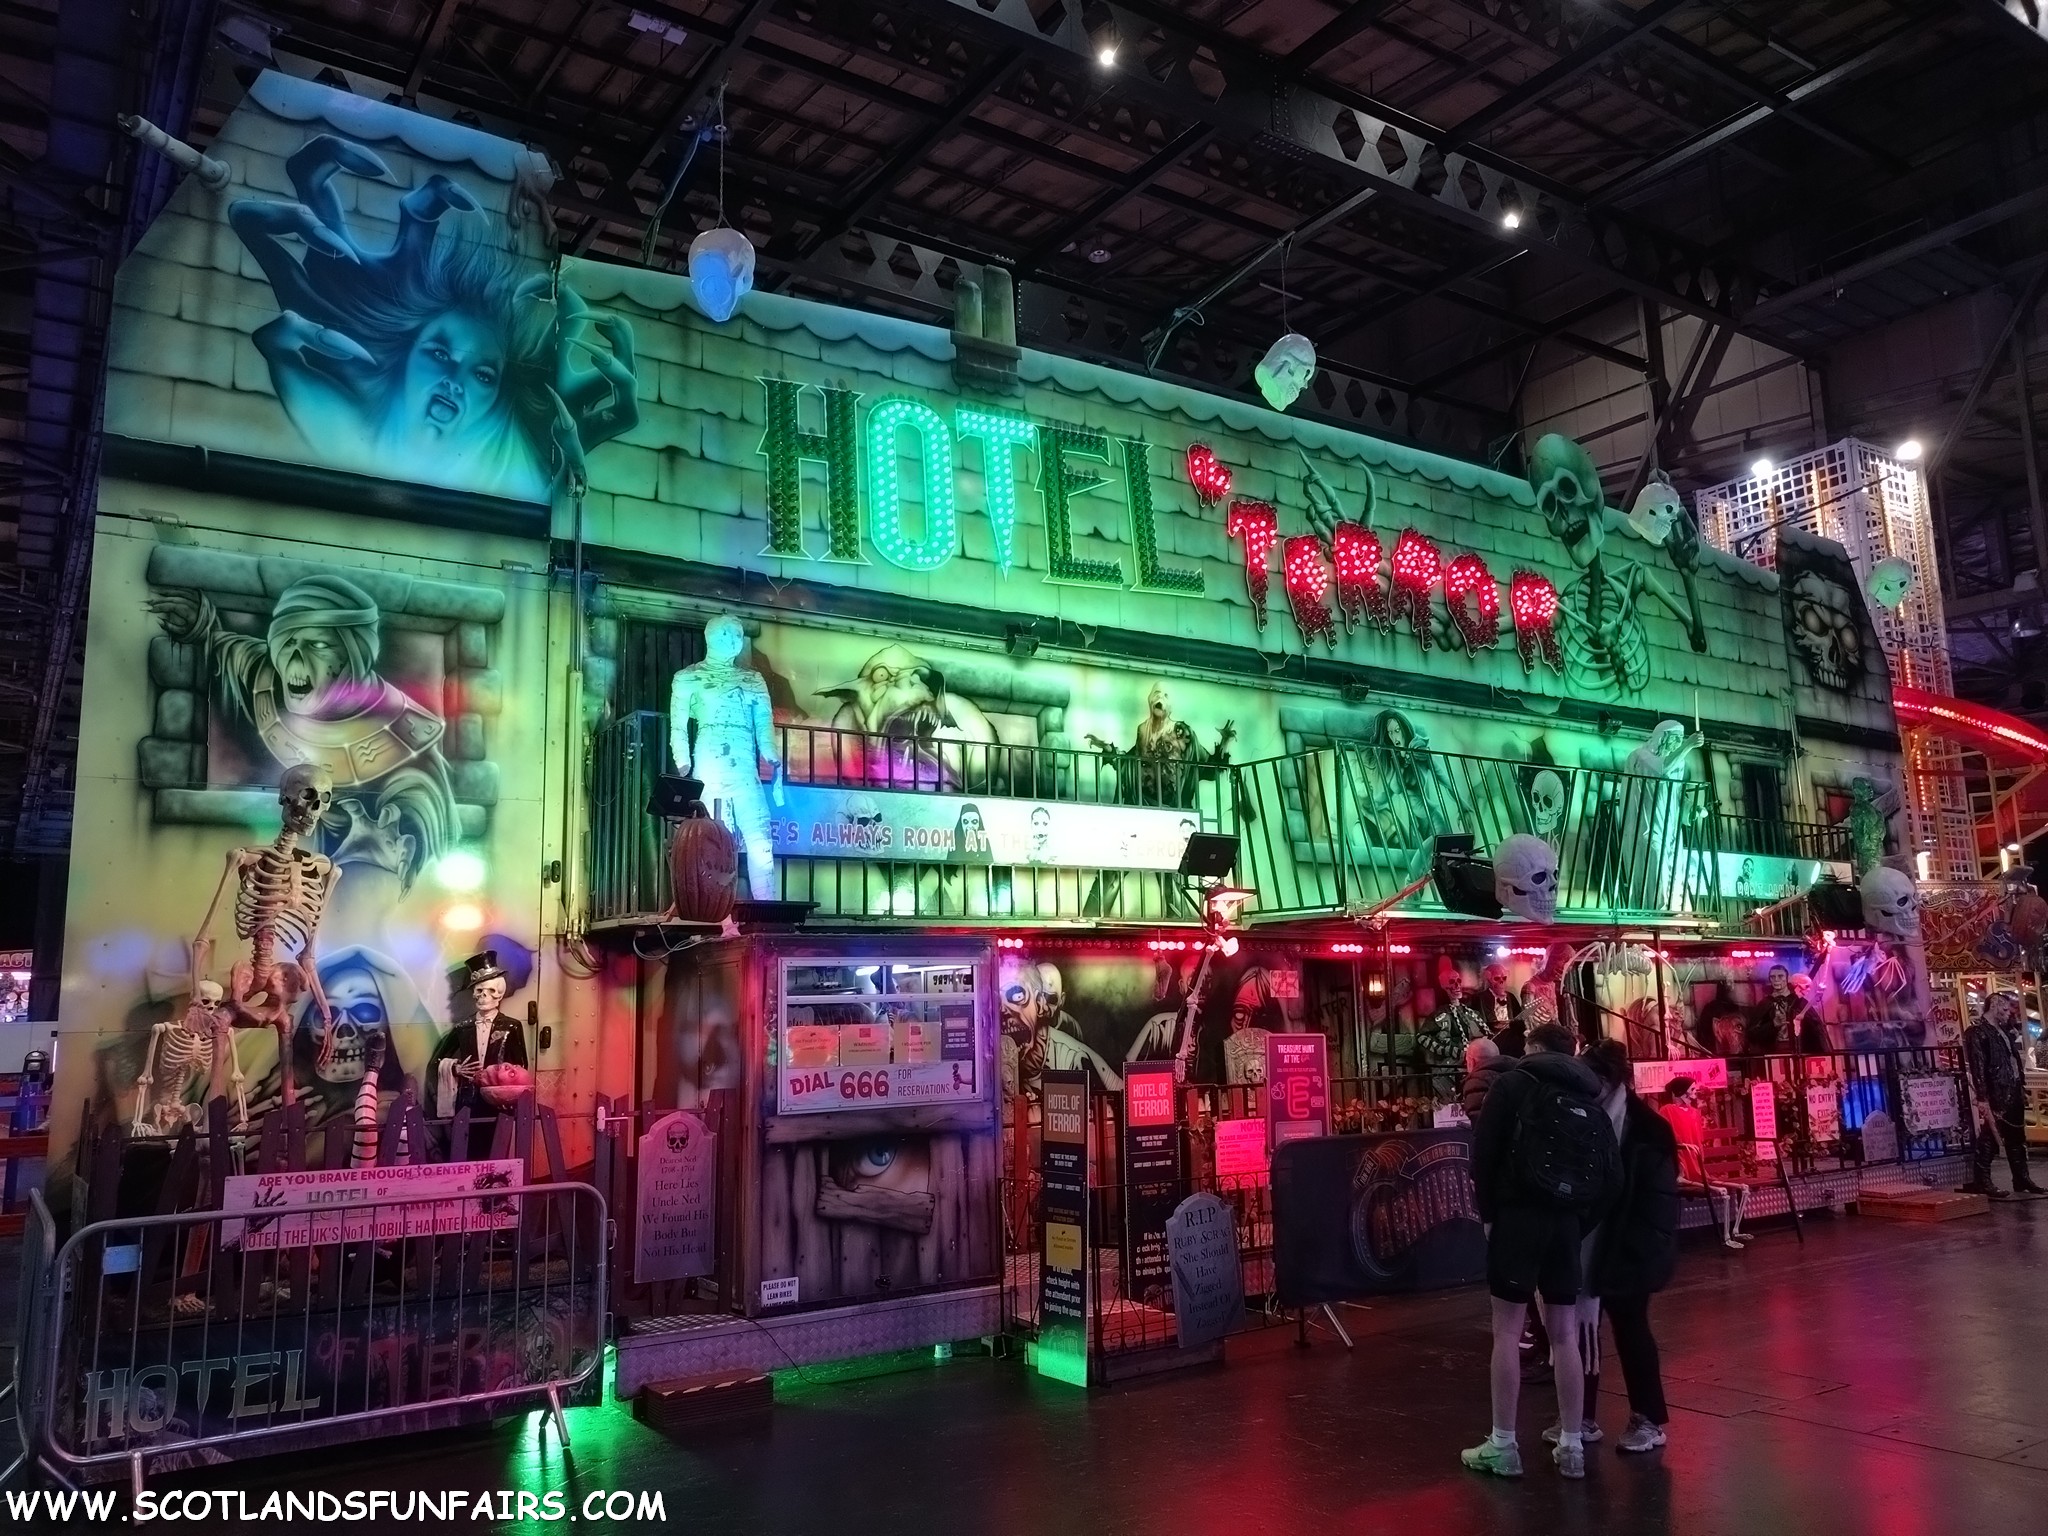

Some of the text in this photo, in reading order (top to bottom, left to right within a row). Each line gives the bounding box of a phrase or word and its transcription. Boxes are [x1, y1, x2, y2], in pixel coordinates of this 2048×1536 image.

[756, 375, 1205, 598] HOTEL
[1227, 499, 1563, 677] TERROR
[769, 816, 800, 845] E'S
[811, 821, 892, 848] ALWAYS
[903, 825, 956, 851] ROOM
[964, 827, 989, 855] AT
[1940, 1025, 1954, 1036] THE
[1277, 1044, 1301, 1053] TREASURE
[1284, 1055, 1289, 1063] AT
[1290, 1054, 1300, 1063] THE
[898, 1069, 912, 1080] FOR
[1640, 1065, 1666, 1086] HOTEL
[790, 1070, 889, 1101] DIAL 666
[898, 1083, 950, 1096] RESERVATIONS
[1133, 1082, 1168, 1097] HOTEL OF
[1048, 1094, 1080, 1110] HOTEL OF
[1808, 1093, 1834, 1104] NO ENTRY
[1133, 1099, 1170, 1117] TERROR
[1450, 1109, 1464, 1118] ABO
[1047, 1112, 1081, 1133] TERROR
[1418, 1154, 1430, 1165] THE
[258, 1162, 496, 1187] ARE YOU BRAVE ENOUGH TO ENTER THE
[655, 1179, 699, 1191] Here Lies
[305, 1188, 389, 1221] HOTEL OF
[652, 1194, 700, 1207] Uncle Ned
[642, 1211, 709, 1225] We Found His
[1185, 1206, 1216, 1228] R.I.P
[284, 1229, 308, 1245] THE
[312, 1226, 339, 1243] UK'S
[368, 1220, 412, 1238] MOBILE
[415, 1216, 468, 1234] HAUNTED
[472, 1213, 508, 1229] HOUSE
[654, 1228, 697, 1242] Body But
[644, 1243, 706, 1257] Not His Head
[1136, 1243, 1150, 1253] ceck
[1201, 1243, 1229, 1259] Should
[1144, 1254, 1166, 1264] attendat
[1142, 1267, 1156, 1276] oining
[1196, 1265, 1217, 1278] Have
[763, 1282, 779, 1290] PLEASE
[788, 1279, 796, 1287] NOT
[1046, 1275, 1079, 1290] check height with
[1194, 1279, 1221, 1296] Zigged
[767, 1290, 792, 1300] LEAN BIKES
[1052, 1290, 1070, 1302] attendant
[1071, 1294, 1080, 1304] prior
[1044, 1301, 1048, 1310] to
[1049, 1302, 1061, 1314] joining
[1069, 1307, 1081, 1317] queue
[1188, 1298, 1218, 1314] Instead
[81, 1349, 321, 1444] HOTEL
